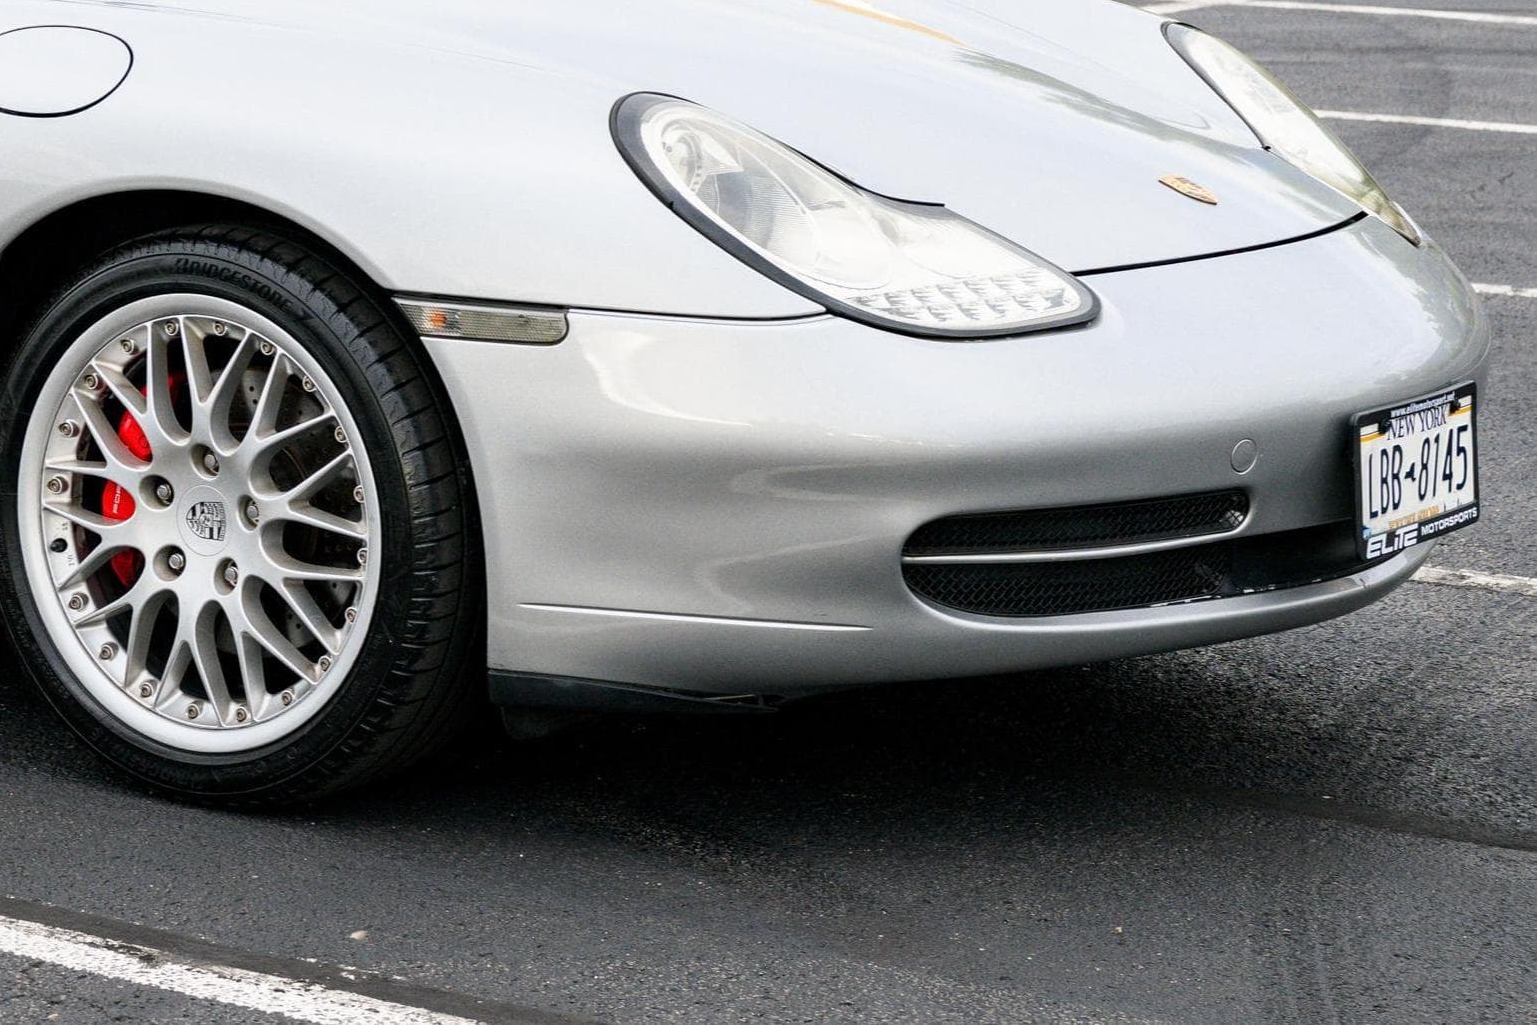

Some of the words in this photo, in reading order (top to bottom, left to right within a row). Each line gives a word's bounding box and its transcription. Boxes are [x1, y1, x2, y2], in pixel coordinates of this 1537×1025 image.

[1387, 413, 1416, 441] NEW
[1419, 403, 1447, 432] YORK
[1369, 444, 1404, 519] LBB
[1419, 424, 1468, 501] 8145
[1422, 506, 1478, 535] MOTORSPORTS
